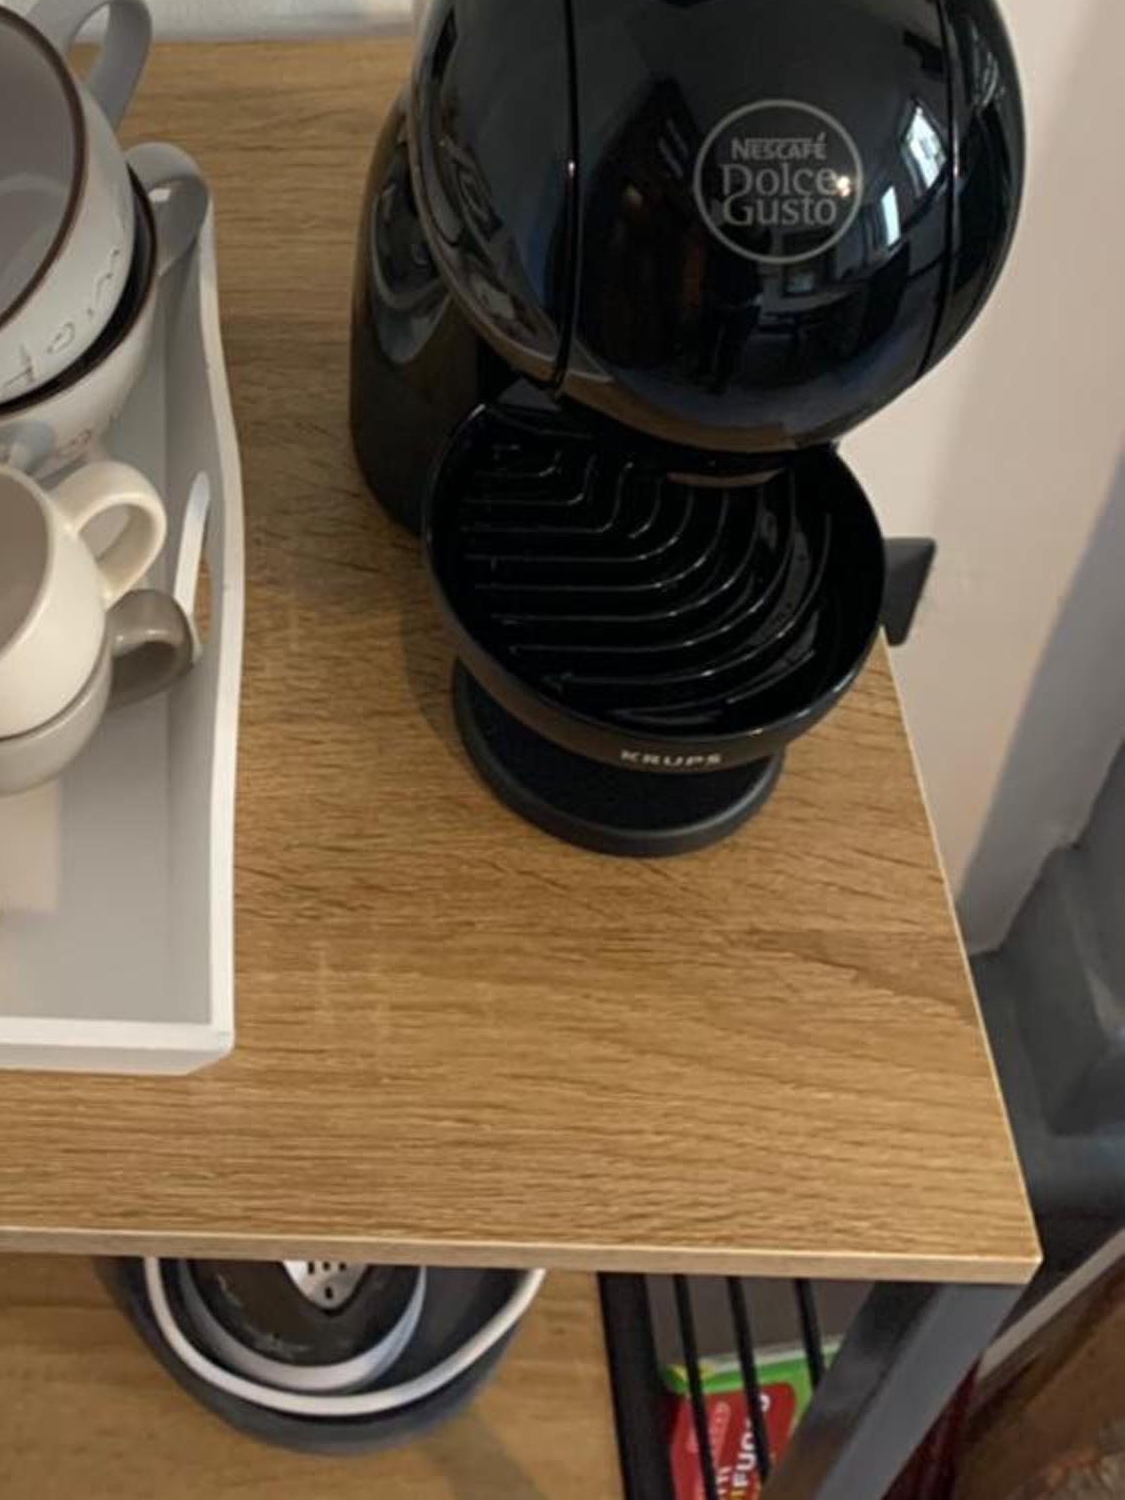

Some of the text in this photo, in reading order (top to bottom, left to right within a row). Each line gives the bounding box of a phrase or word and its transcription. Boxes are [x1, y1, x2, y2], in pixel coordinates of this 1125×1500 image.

[731, 132, 827, 161] NESCAFÉ
[719, 162, 838, 197] Dolce
[723, 196, 837, 226] Gusto
[620, 750, 722, 767] KRUPS
